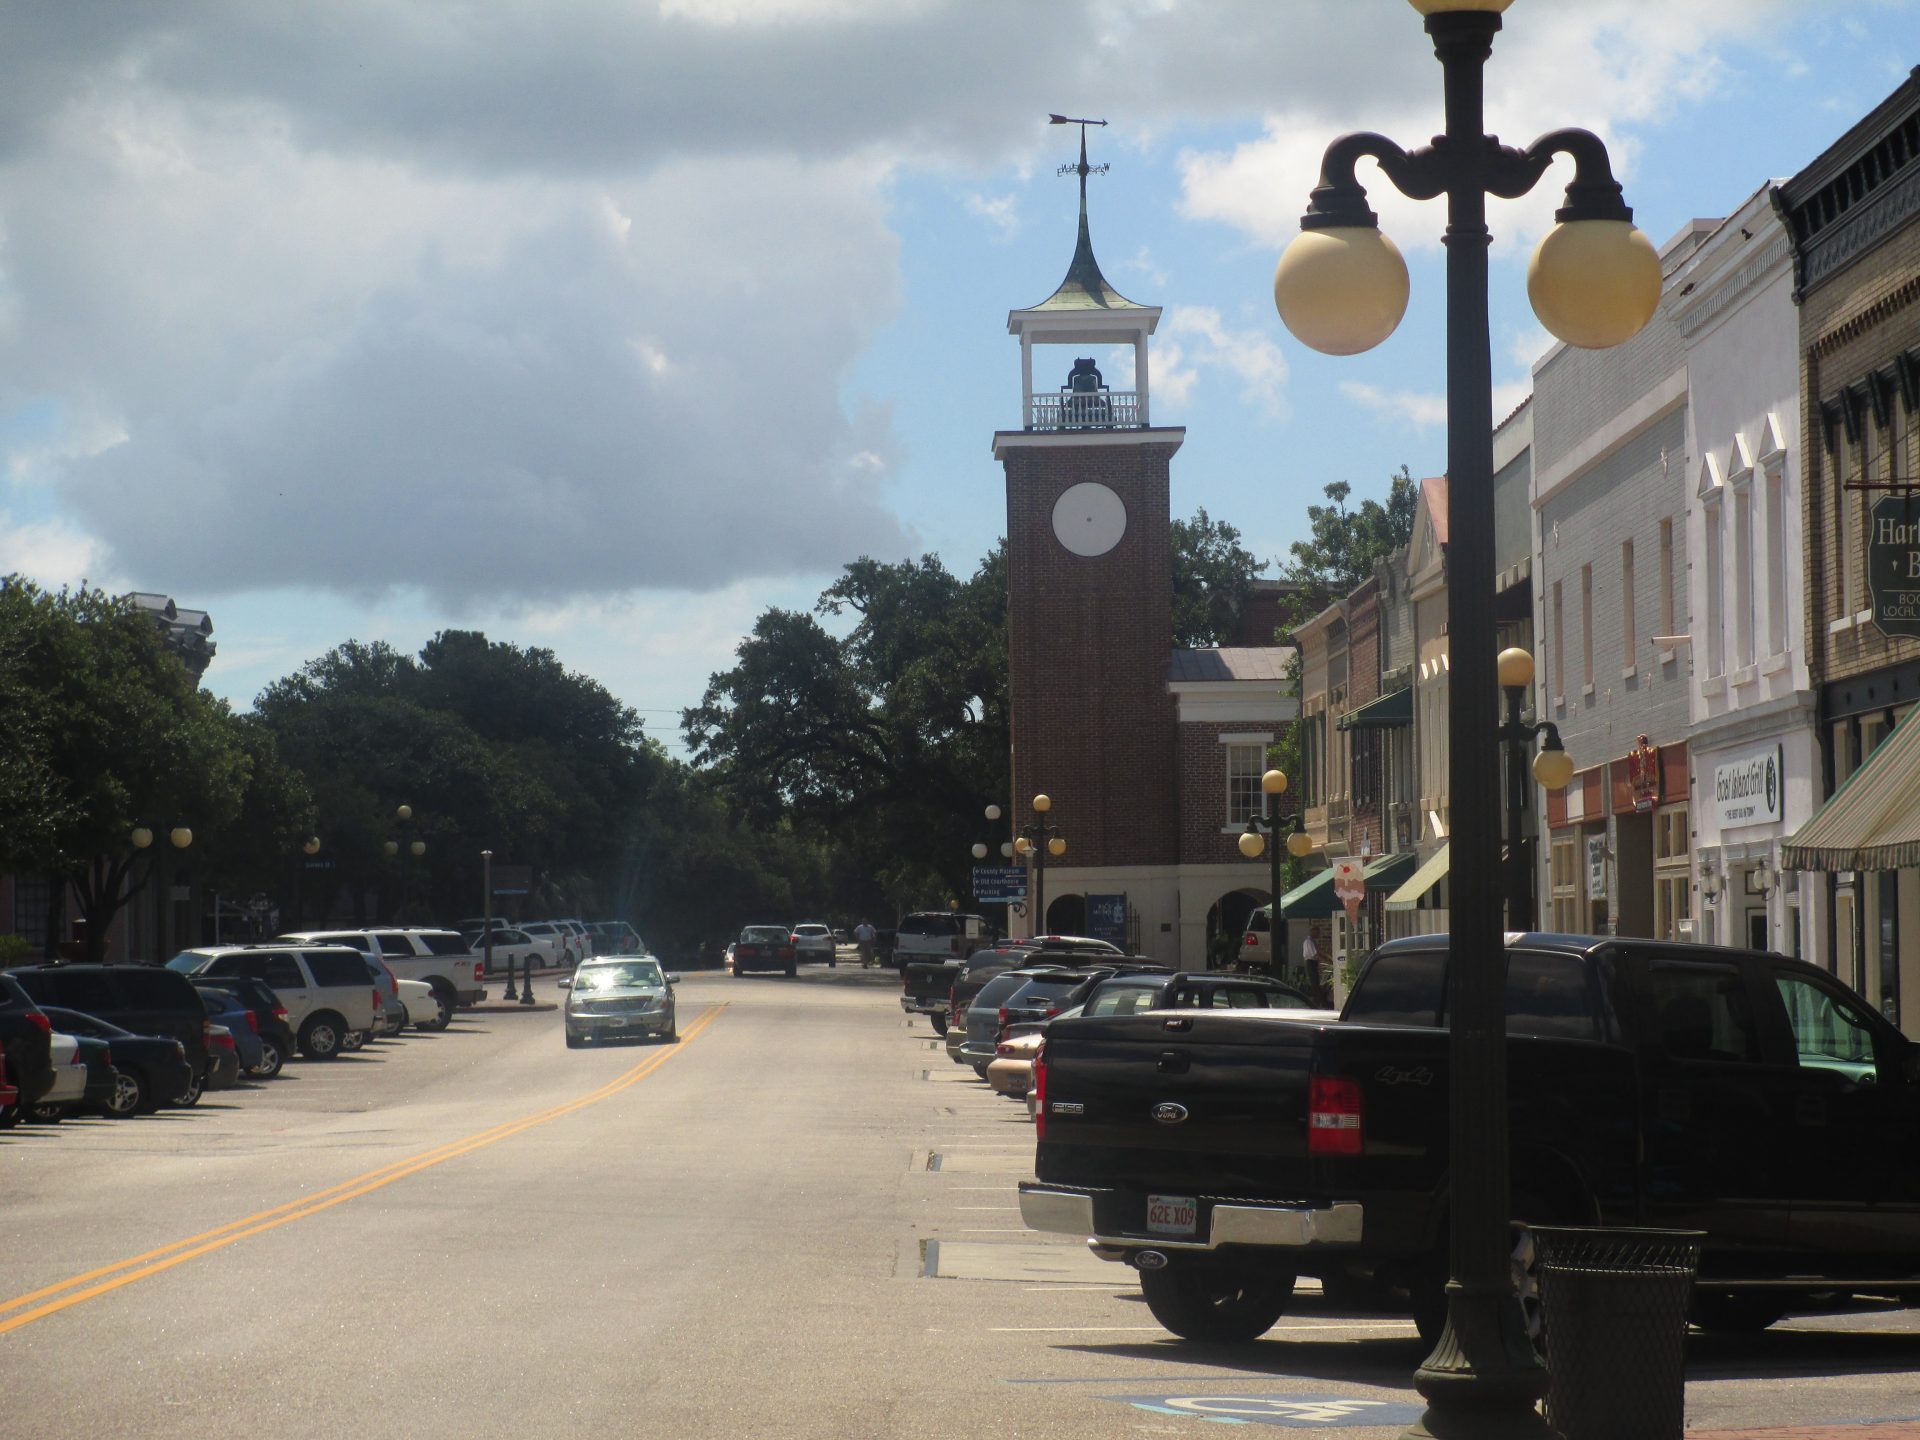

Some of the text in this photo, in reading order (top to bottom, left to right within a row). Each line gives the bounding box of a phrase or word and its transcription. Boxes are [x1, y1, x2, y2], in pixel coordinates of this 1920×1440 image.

[1877, 517, 1920, 545] Har
[1882, 604, 1917, 617] LOCAL
[1716, 761, 1763, 802] Goat Island Grill
[1157, 1105, 1178, 1119] Ford
[1150, 1205, 1194, 1226] 62E X09
[1141, 1254, 1158, 1265] Ford
